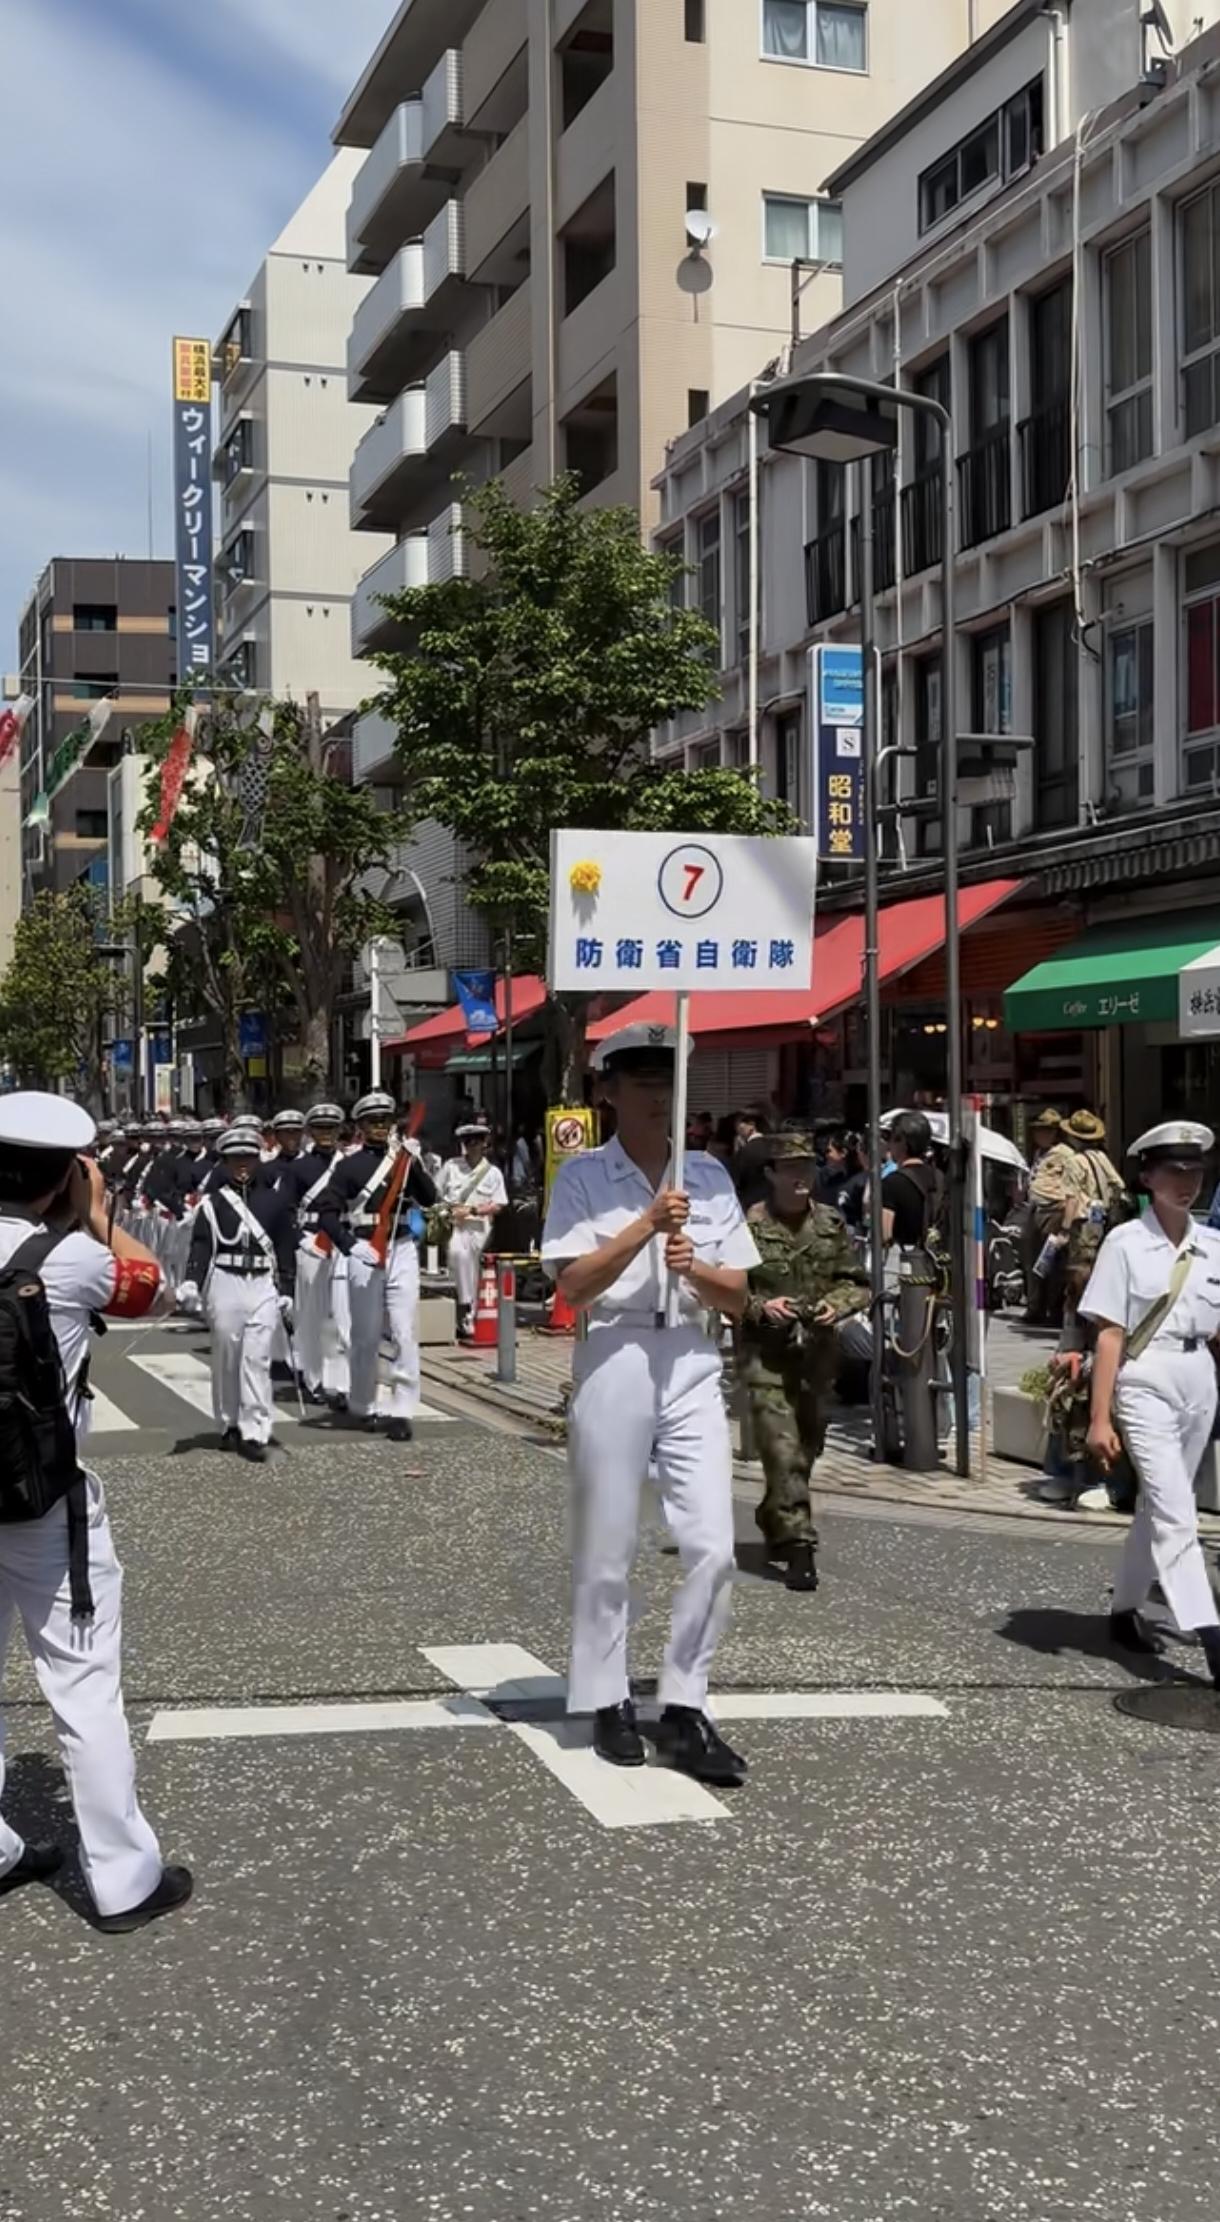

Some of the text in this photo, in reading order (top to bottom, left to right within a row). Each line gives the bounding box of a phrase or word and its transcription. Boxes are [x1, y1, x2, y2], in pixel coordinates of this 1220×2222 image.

[828, 774, 853, 853] 昭和堂
[682, 863, 705, 901] 7
[575, 937, 795, 970] 防衛省自衛隊
[1097, 991, 1140, 1016] エリーゼ
